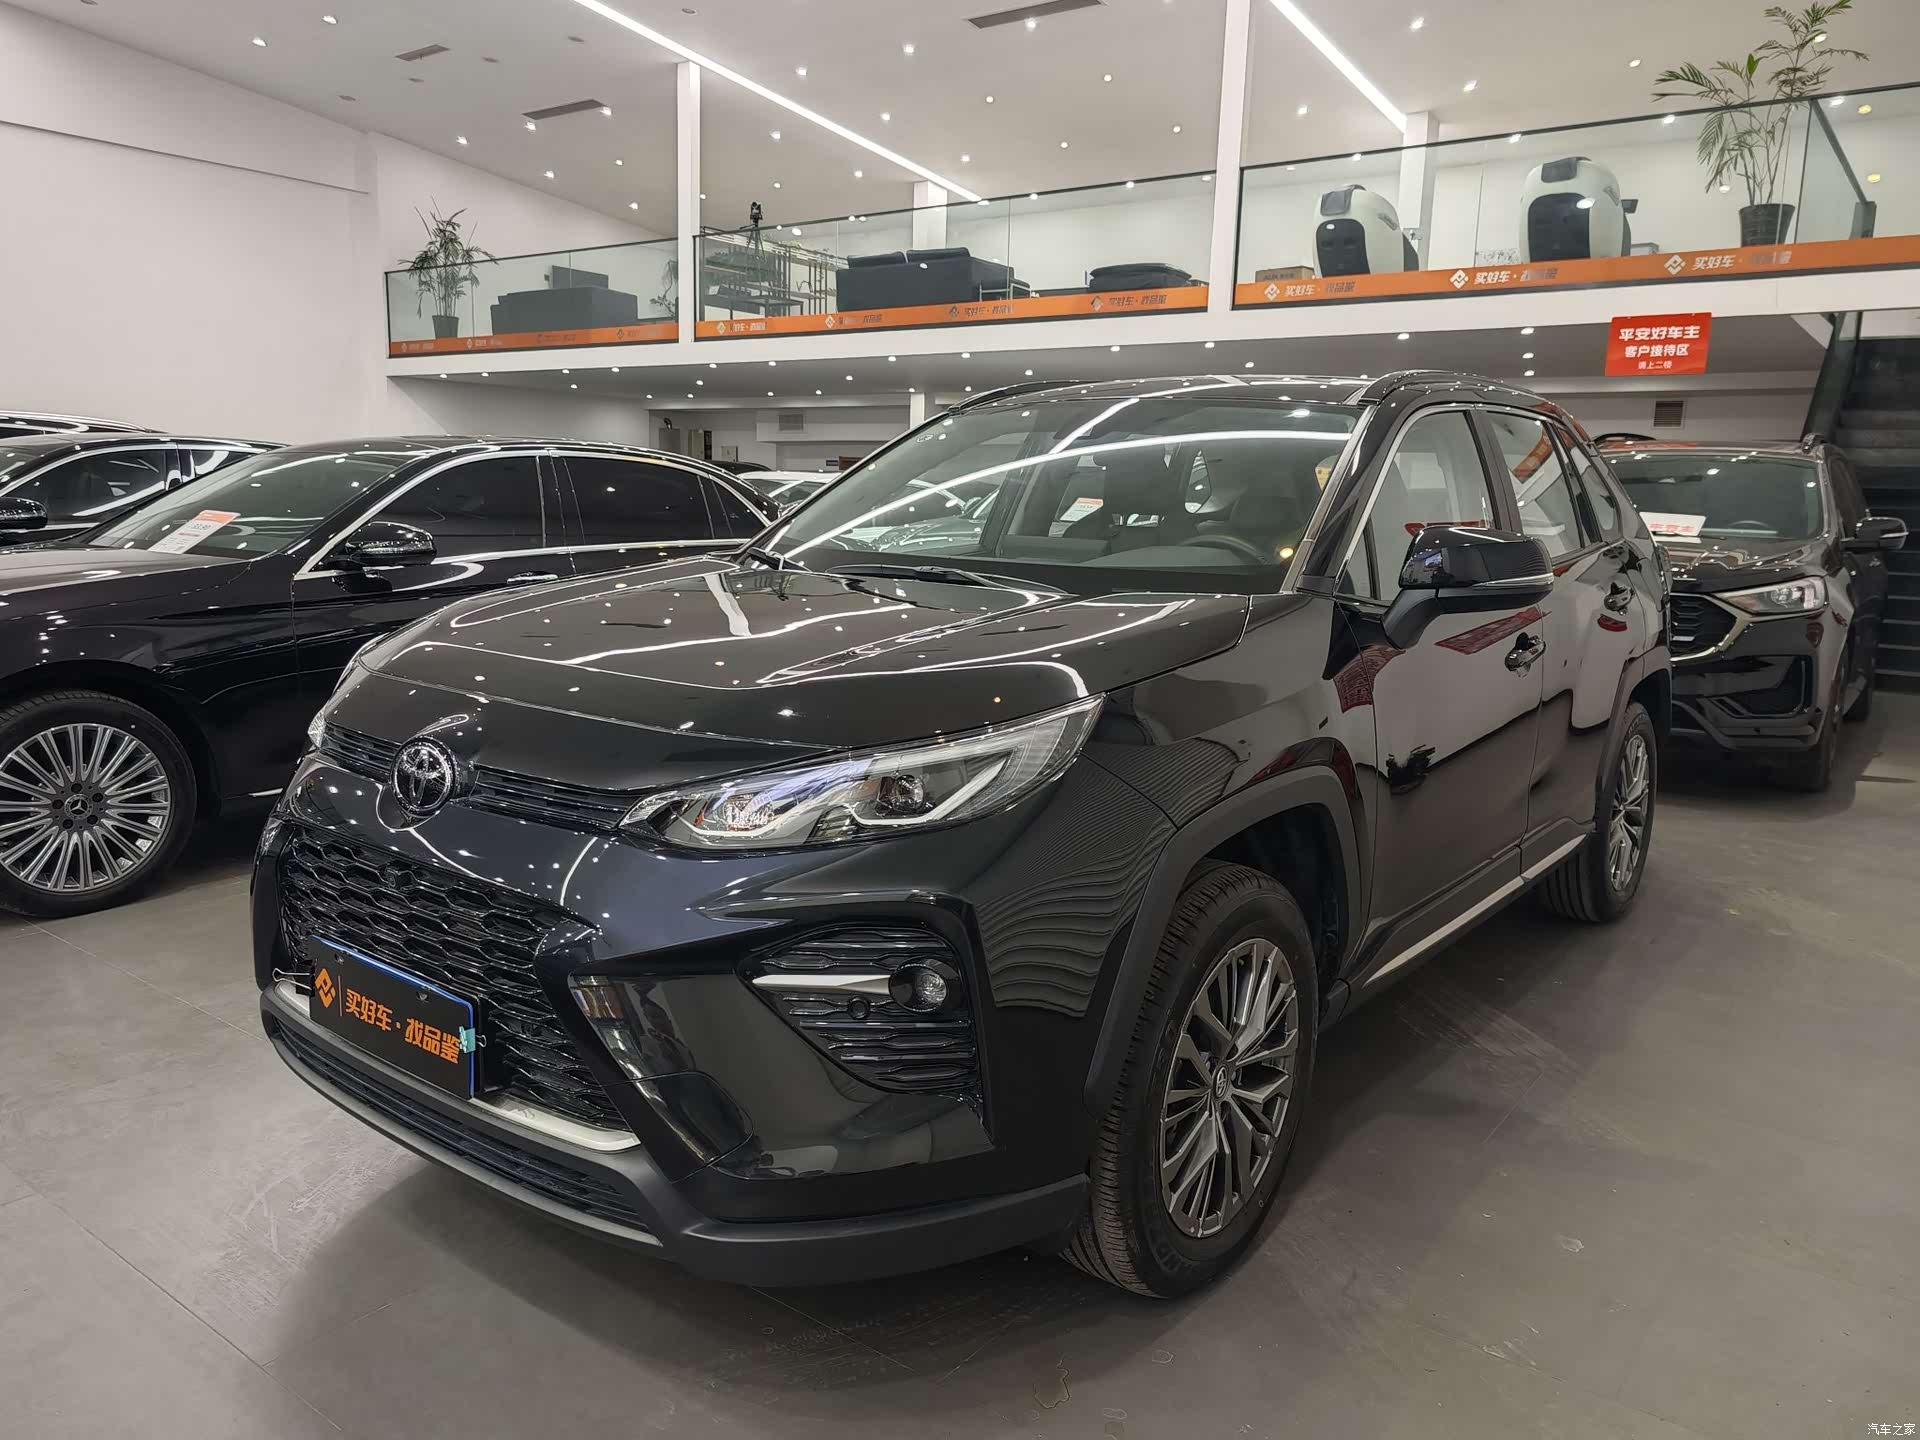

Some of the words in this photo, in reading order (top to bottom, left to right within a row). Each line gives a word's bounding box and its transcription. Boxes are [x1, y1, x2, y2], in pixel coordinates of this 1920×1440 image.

[1619, 325, 1700, 341] 平安好车主
[1625, 343, 1690, 358] 客户接待区
